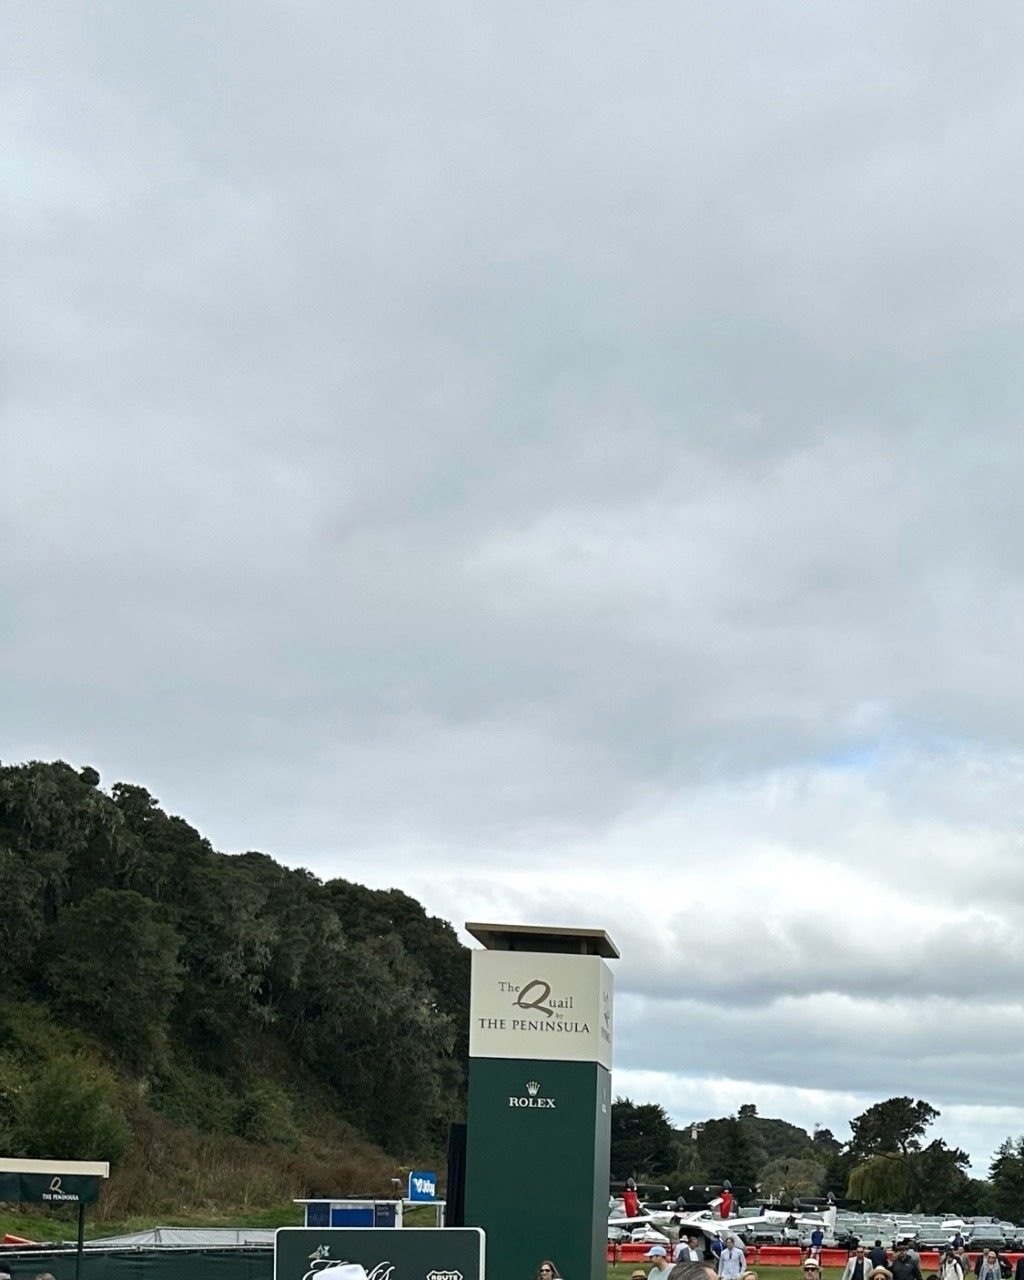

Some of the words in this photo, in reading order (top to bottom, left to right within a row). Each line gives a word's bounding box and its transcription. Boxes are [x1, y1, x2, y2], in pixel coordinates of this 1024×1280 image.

[498, 981, 520, 992] The
[512, 979, 573, 1018] Quail
[478, 1018, 506, 1029] THE
[512, 1019, 590, 1034] PENINSULA
[509, 1097, 556, 1108] ROLEX
